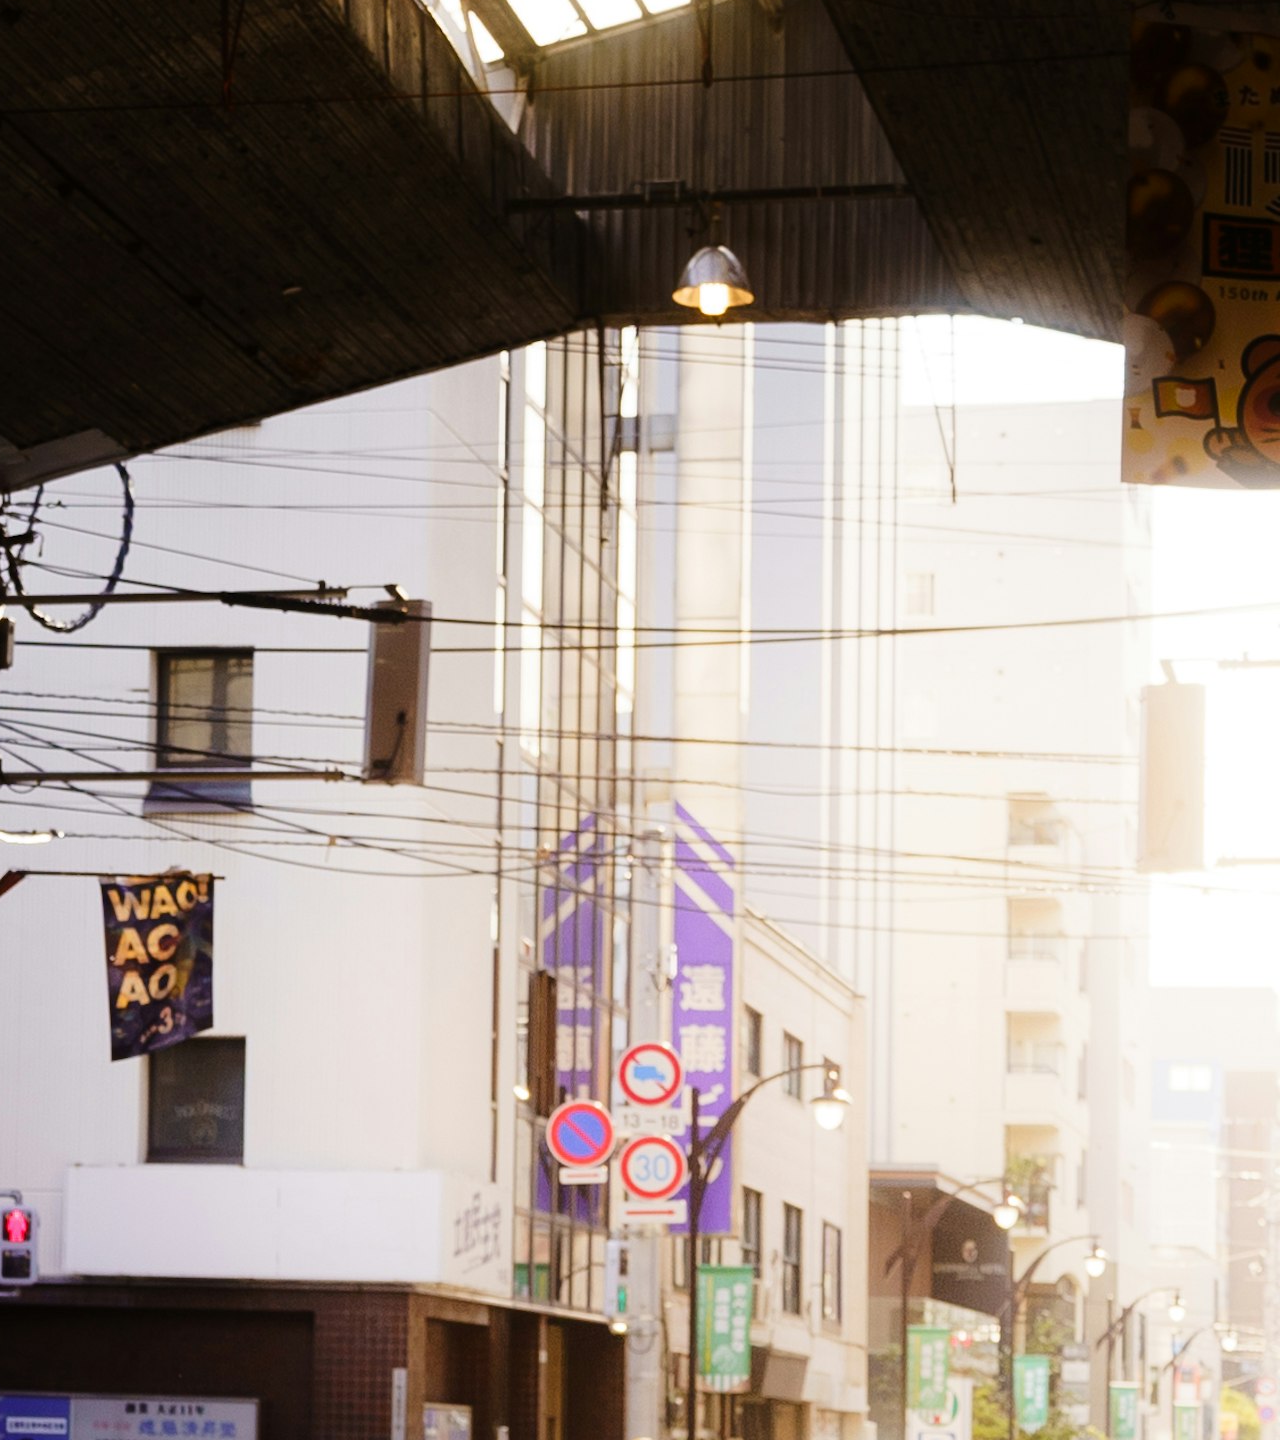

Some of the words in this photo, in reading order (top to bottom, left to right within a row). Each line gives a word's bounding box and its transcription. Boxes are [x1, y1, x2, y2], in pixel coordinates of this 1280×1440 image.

[1218, 286, 1269, 302] 150th
[108, 875, 209, 922] WAO!
[114, 923, 180, 966] AC
[116, 964, 178, 1009] AO
[634, 1154, 671, 1182] 30
